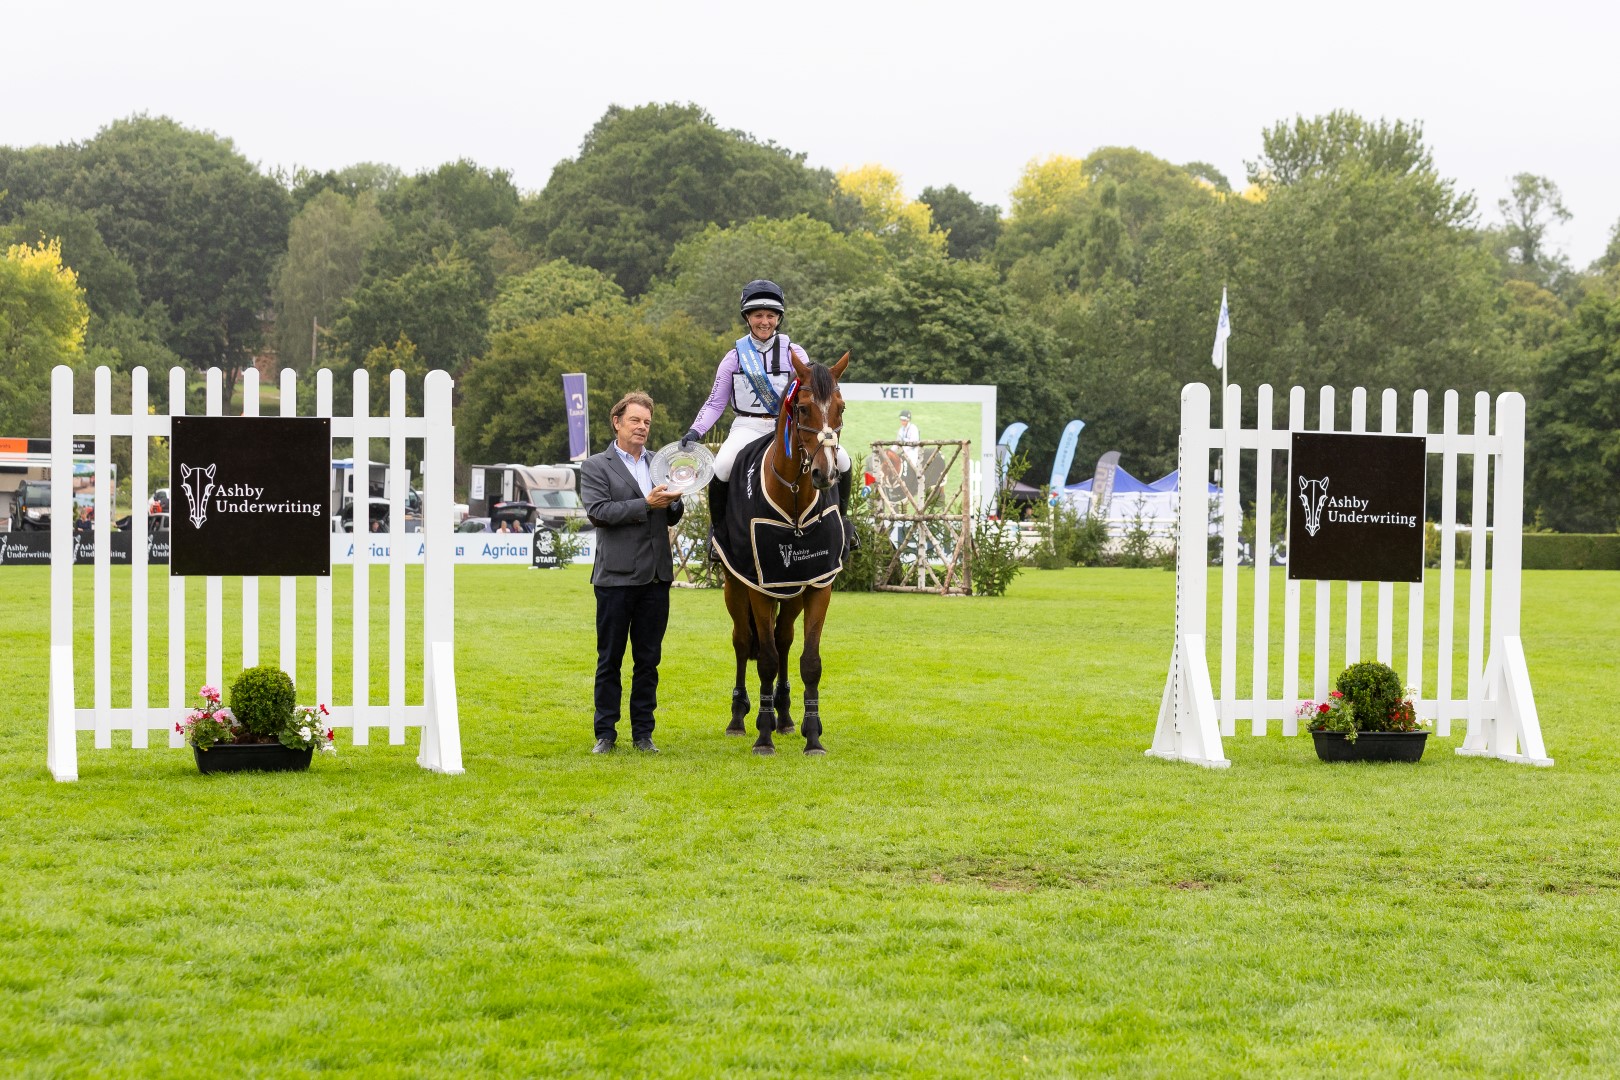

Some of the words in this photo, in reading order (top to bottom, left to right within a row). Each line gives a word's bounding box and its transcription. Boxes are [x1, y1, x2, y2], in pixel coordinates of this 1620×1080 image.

[880, 386, 914, 399] YETI
[215, 484, 265, 500] Ashby
[216, 500, 322, 517] Underwriting
[1328, 495, 1369, 512] Ashby
[1328, 510, 1417, 528] Underwriting
[6, 543, 28, 552] Ashby
[79, 543, 94, 551] Ash
[152, 543, 169, 551] Ashb
[482, 543, 520, 560] Agria
[792, 548, 810, 556] Ashby
[7, 551, 51, 559] Underwriting
[535, 556, 557, 564] START
[792, 549, 829, 562] Underwriting
